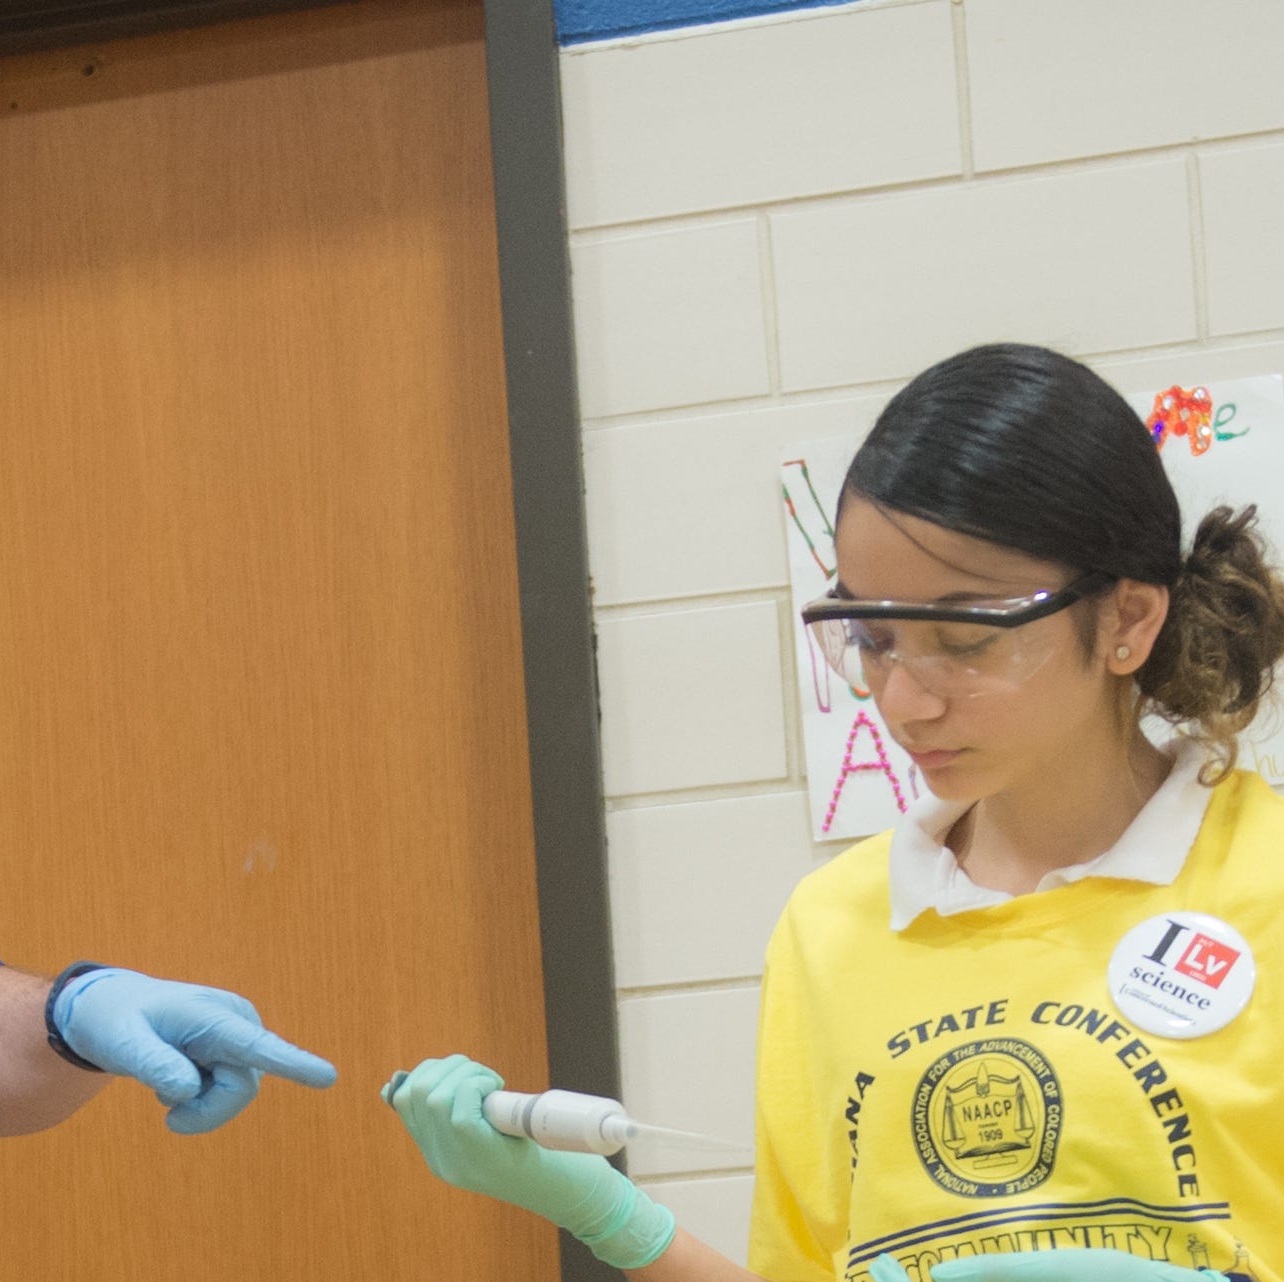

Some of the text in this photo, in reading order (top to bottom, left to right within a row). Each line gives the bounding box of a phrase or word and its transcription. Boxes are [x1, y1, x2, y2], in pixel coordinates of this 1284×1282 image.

[1141, 918, 1190, 967] I
[1129, 966, 1212, 1010] science
[886, 999, 1009, 1060] STATE
[1030, 1000, 1201, 1199] CONFERENCE
[915, 1040, 1061, 1196] NATIONAL ASSOCIATION FOR THE ADVANCEMENT OF COLORED PEOPLE
[962, 1099, 1013, 1123] NAACP
[978, 1128, 1004, 1142] 1909
